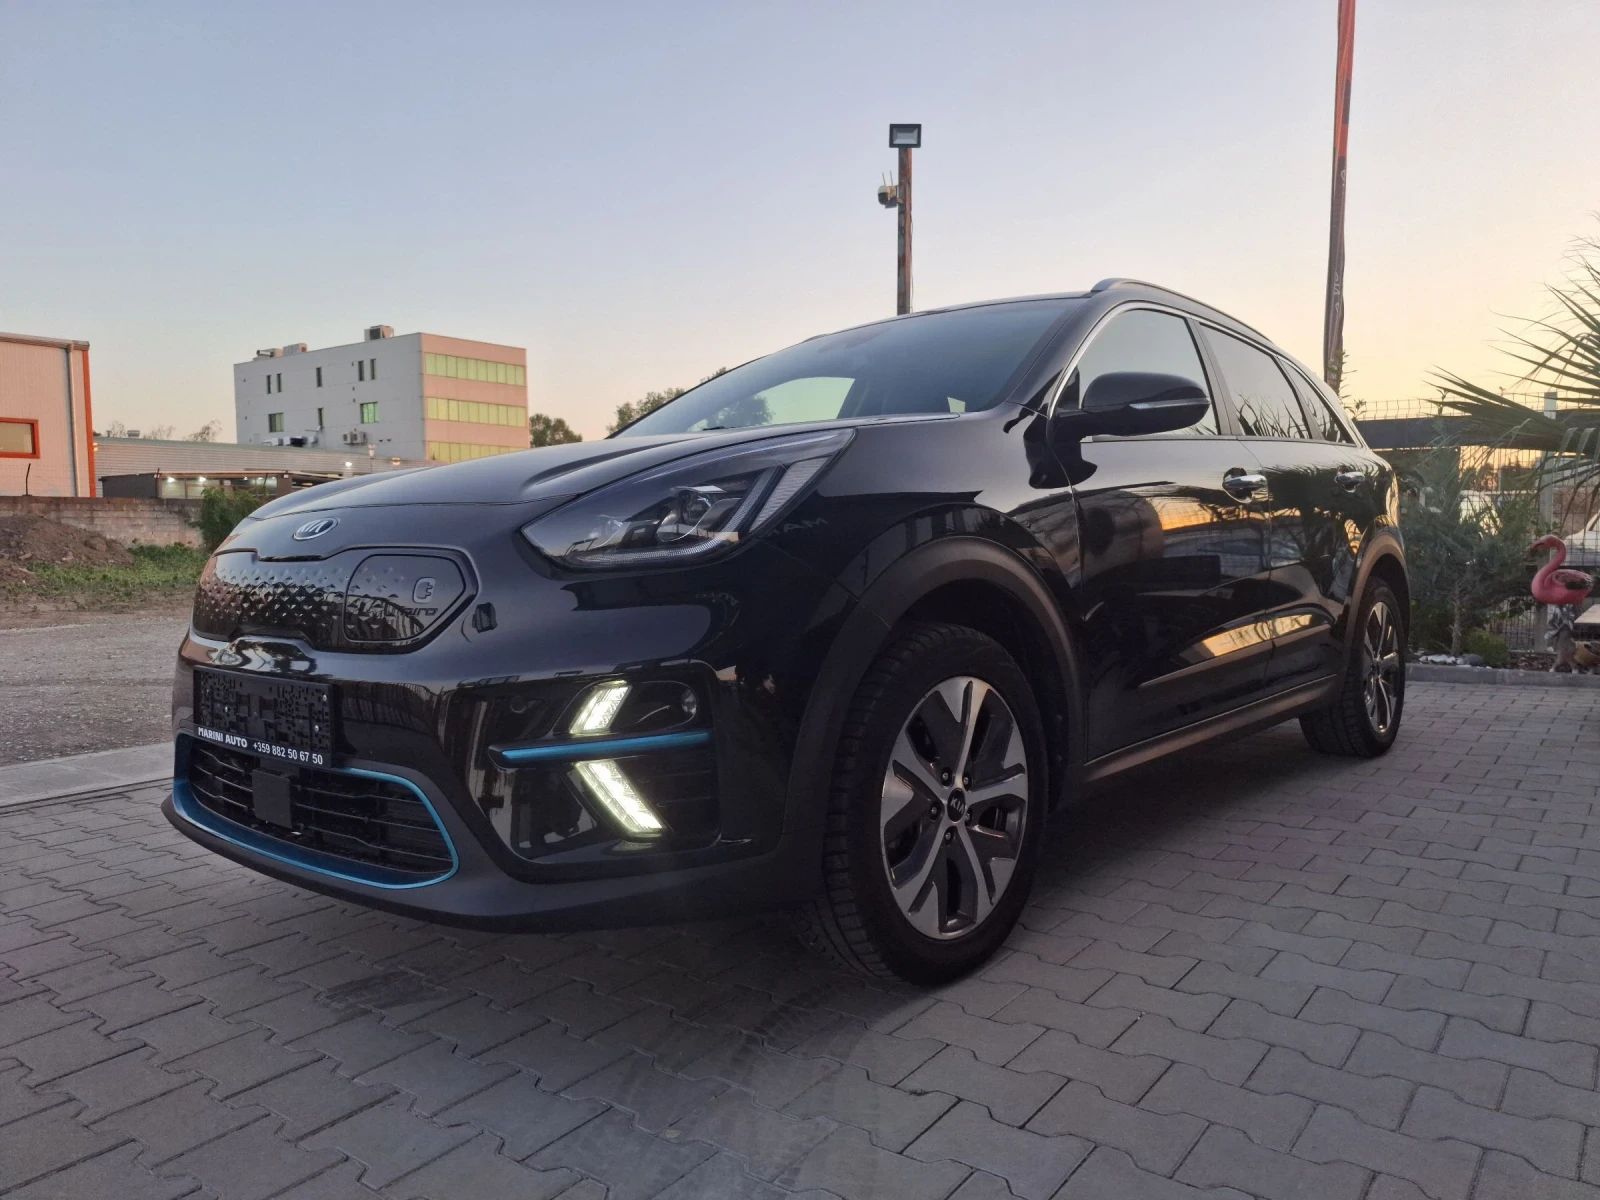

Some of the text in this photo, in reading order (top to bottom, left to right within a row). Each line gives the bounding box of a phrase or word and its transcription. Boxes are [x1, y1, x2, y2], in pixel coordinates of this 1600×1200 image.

[298, 519, 329, 533] KIA
[198, 726, 324, 765] MARINI AUTO +359 882 50 67 50
[950, 796, 965, 815] KIA
